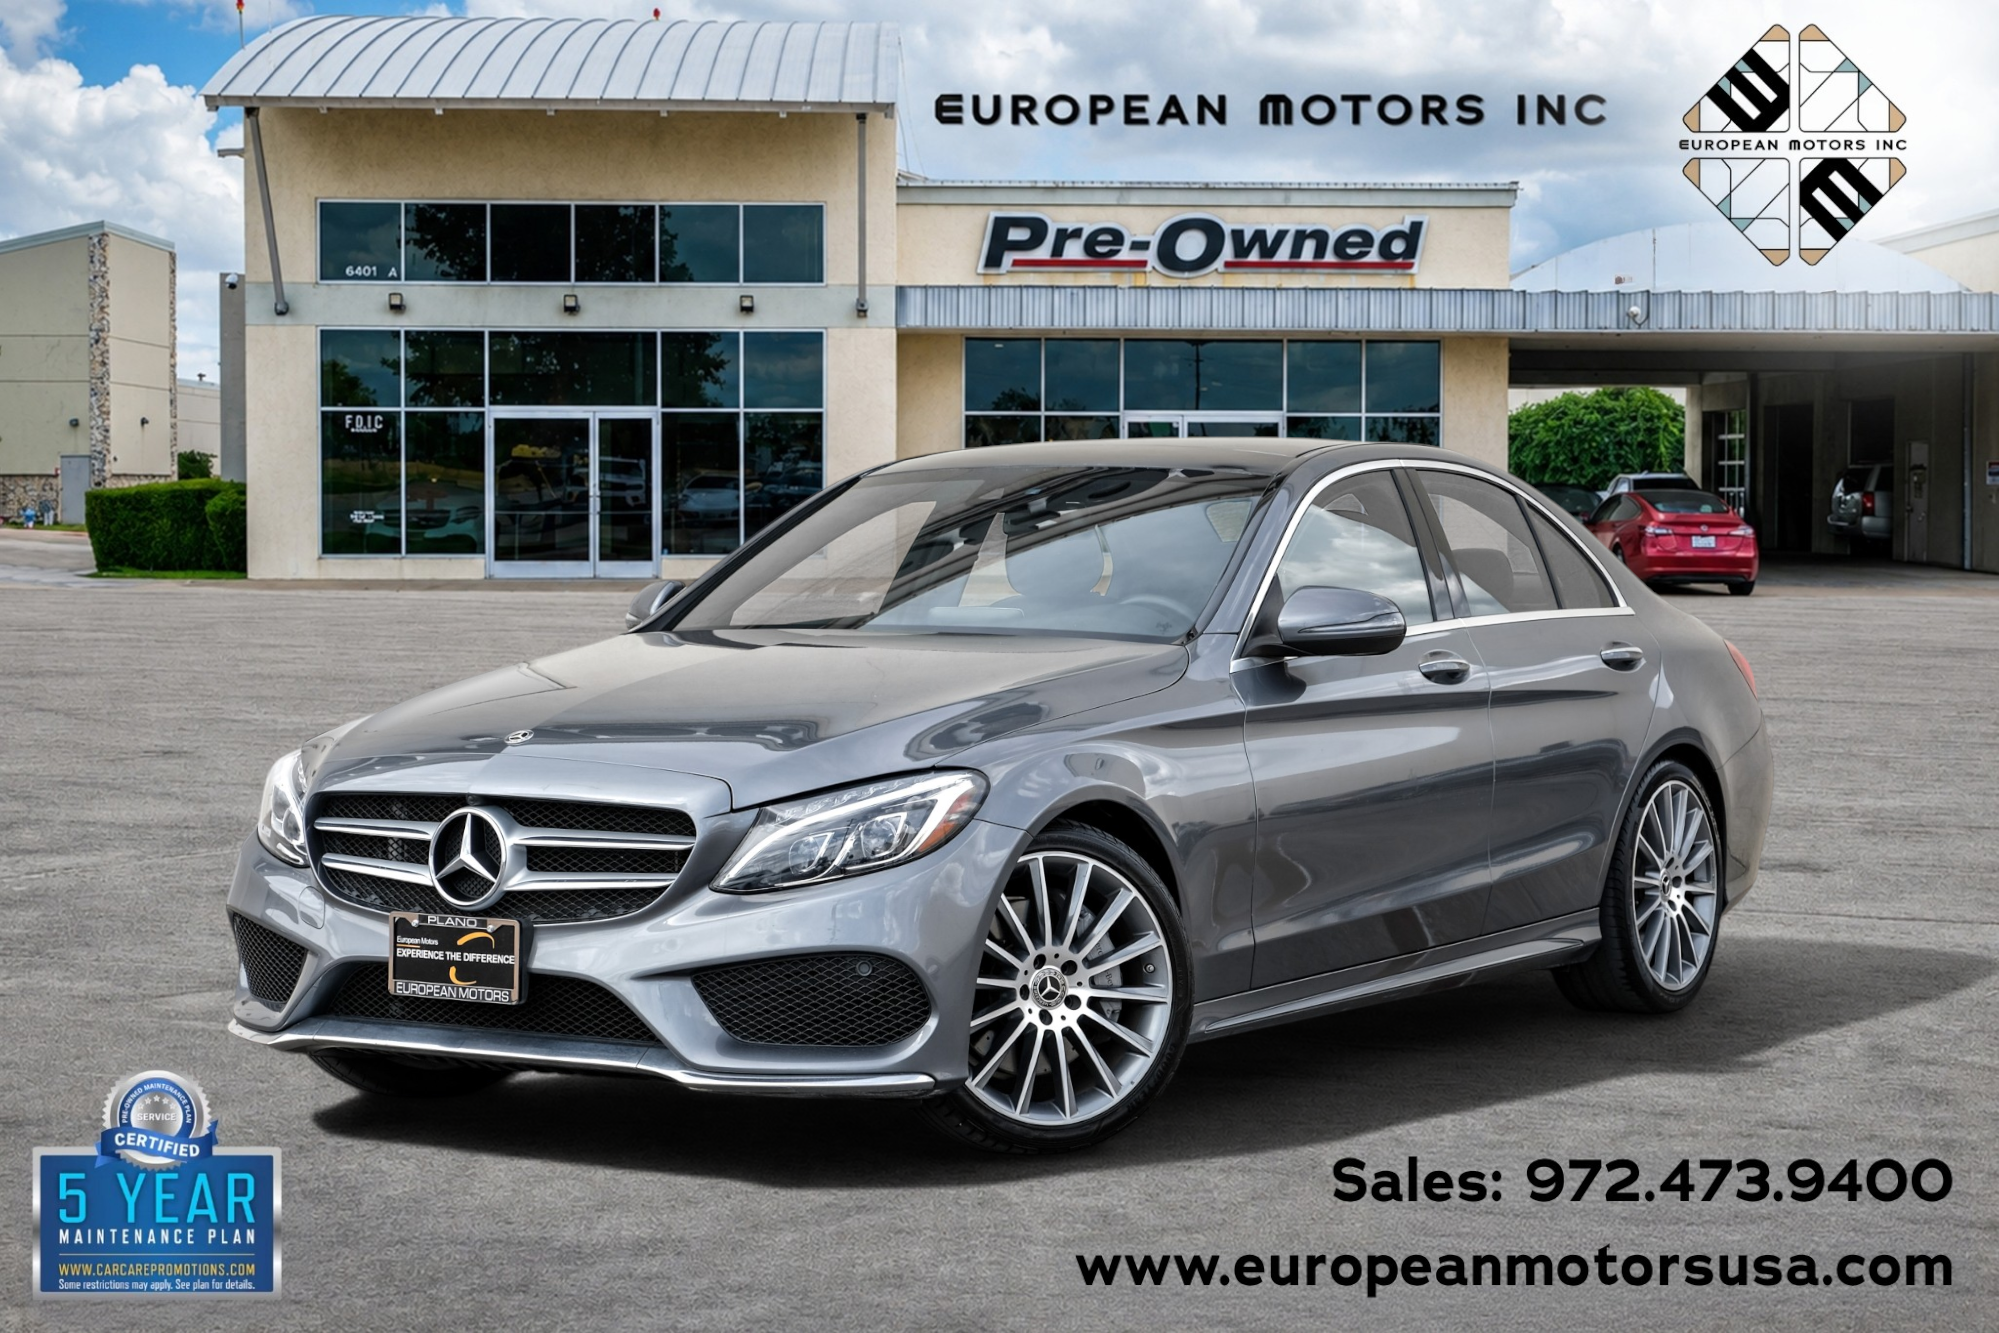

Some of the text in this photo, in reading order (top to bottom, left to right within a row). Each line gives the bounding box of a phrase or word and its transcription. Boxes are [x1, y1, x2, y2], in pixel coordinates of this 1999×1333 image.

[983, 215, 1423, 273] Pre-Owned
[345, 265, 398, 278] 6401 A
[427, 915, 477, 928] PLANO
[396, 935, 439, 946] European Motors
[396, 948, 515, 965] EXPERIENCE THE DIFFERENCE
[396, 981, 509, 1002] EUROPEAN MOTORS
